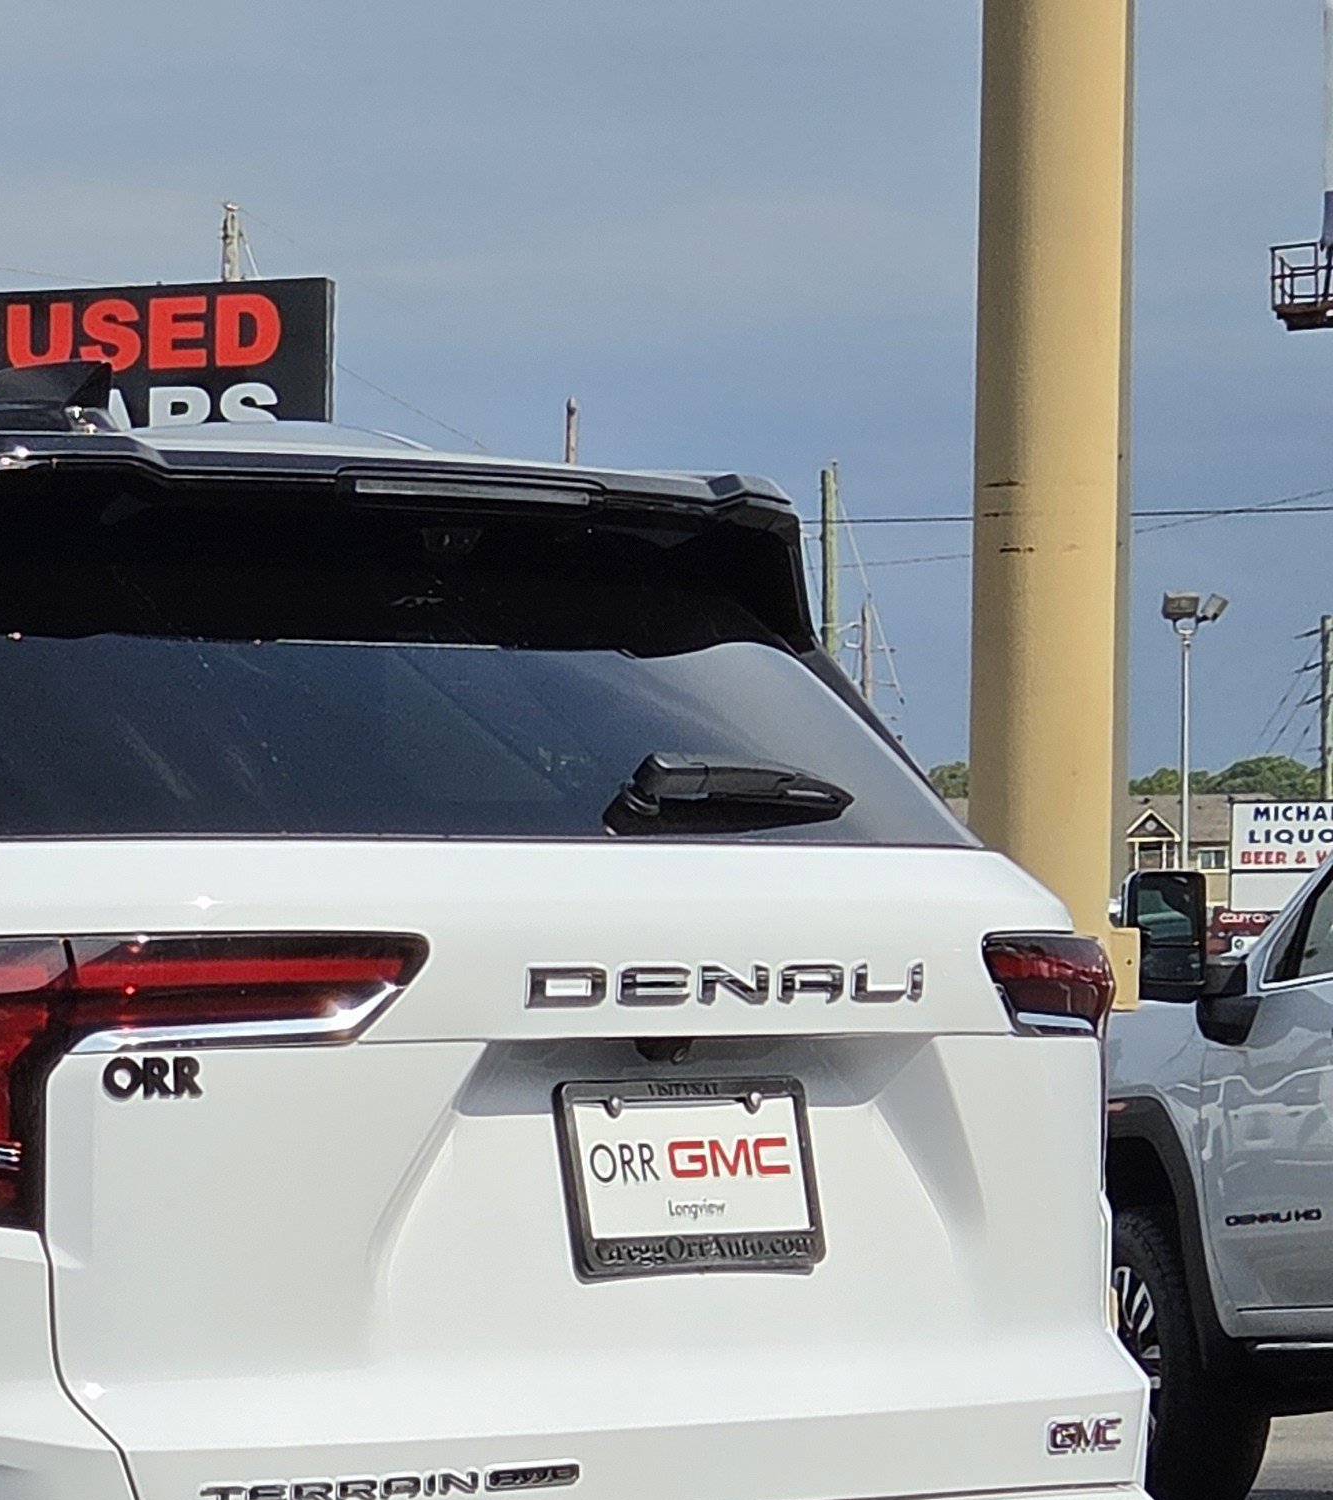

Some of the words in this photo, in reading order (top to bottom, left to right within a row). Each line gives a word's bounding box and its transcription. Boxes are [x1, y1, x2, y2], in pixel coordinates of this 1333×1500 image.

[6, 293, 282, 372] USED
[108, 383, 279, 428] RS
[1240, 851, 1287, 865] BEER
[1295, 851, 1307, 865] &
[1248, 829, 1333, 845] LIQUO
[523, 961, 925, 1009] DENALI
[102, 1056, 204, 1102] ORR
[589, 1142, 661, 1184] ORR
[667, 1137, 792, 1179] GMC
[668, 1198, 726, 1219] Longview
[1294, 1208, 1323, 1222] HD
[1046, 1416, 1123, 1455] GMC
